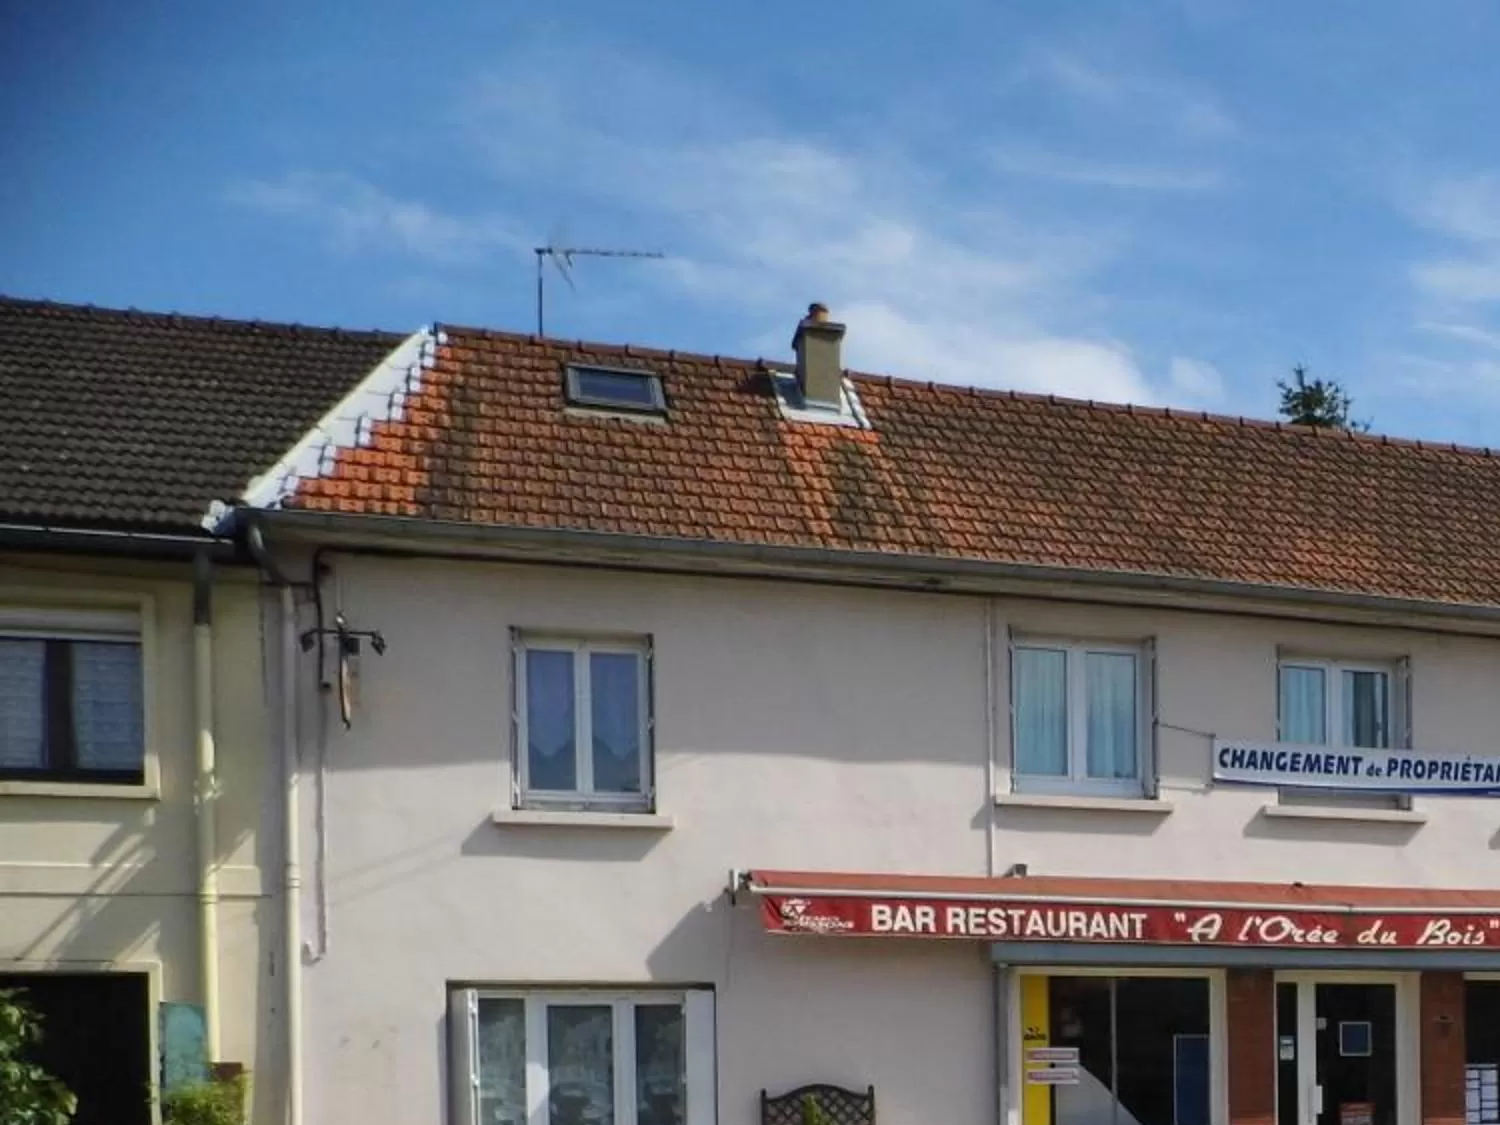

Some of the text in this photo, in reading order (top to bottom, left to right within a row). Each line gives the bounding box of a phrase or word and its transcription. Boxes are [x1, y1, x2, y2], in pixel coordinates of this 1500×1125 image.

[1218, 748, 1363, 776] CHANGEMENT
[1366, 762, 1383, 777] de
[871, 904, 936, 933] BAR
[946, 907, 1148, 939] RESTAURANT
[1357, 919, 1397, 945] du
